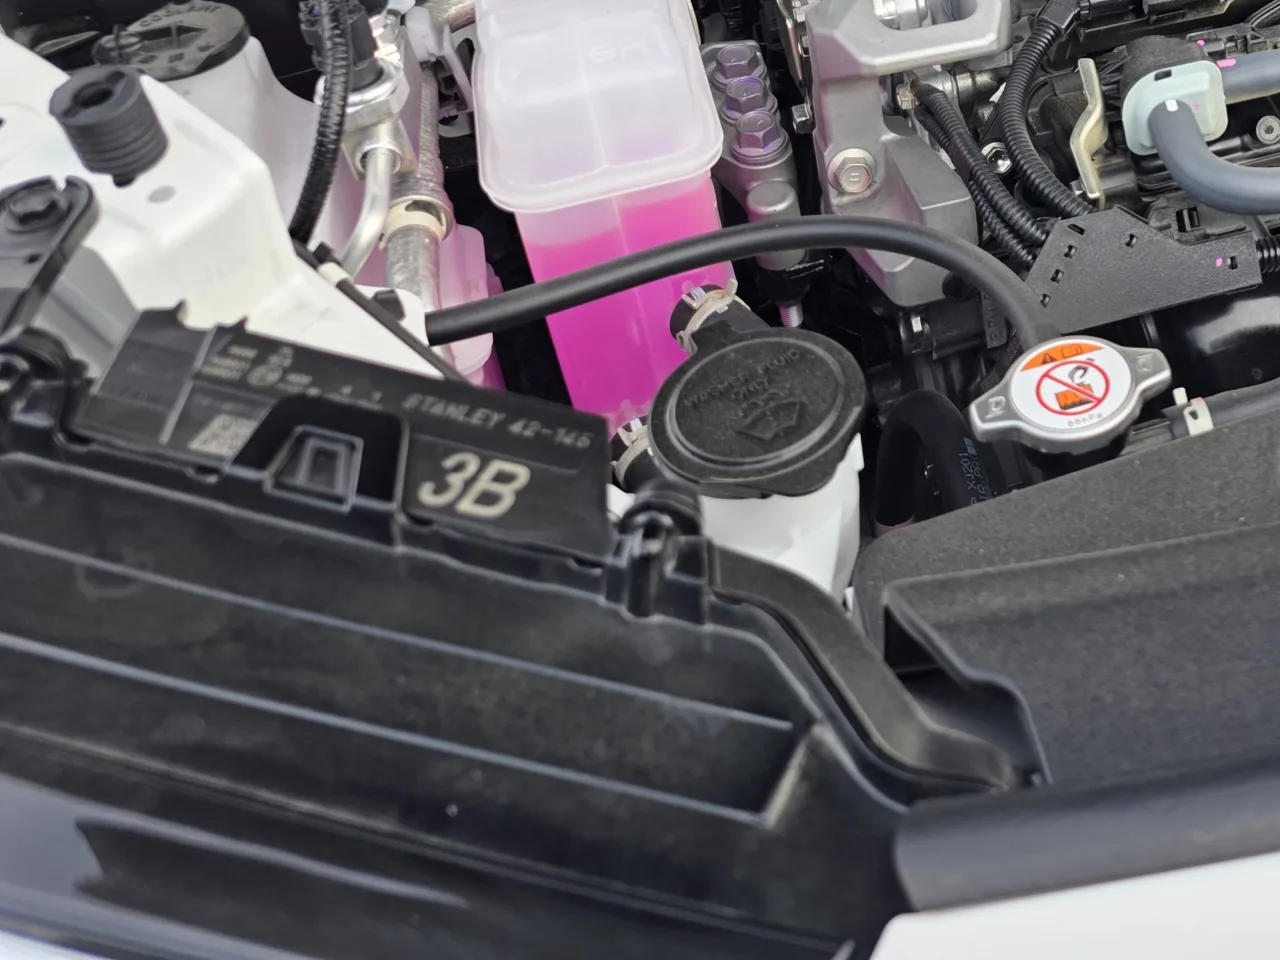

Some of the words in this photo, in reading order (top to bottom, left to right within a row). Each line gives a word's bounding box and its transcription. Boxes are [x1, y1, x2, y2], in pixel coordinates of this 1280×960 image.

[683, 372, 750, 410] WASHER
[755, 348, 800, 375] FLUID
[732, 378, 769, 401] ONLY
[401, 393, 505, 429] STANLEY
[417, 451, 532, 519] 3B
